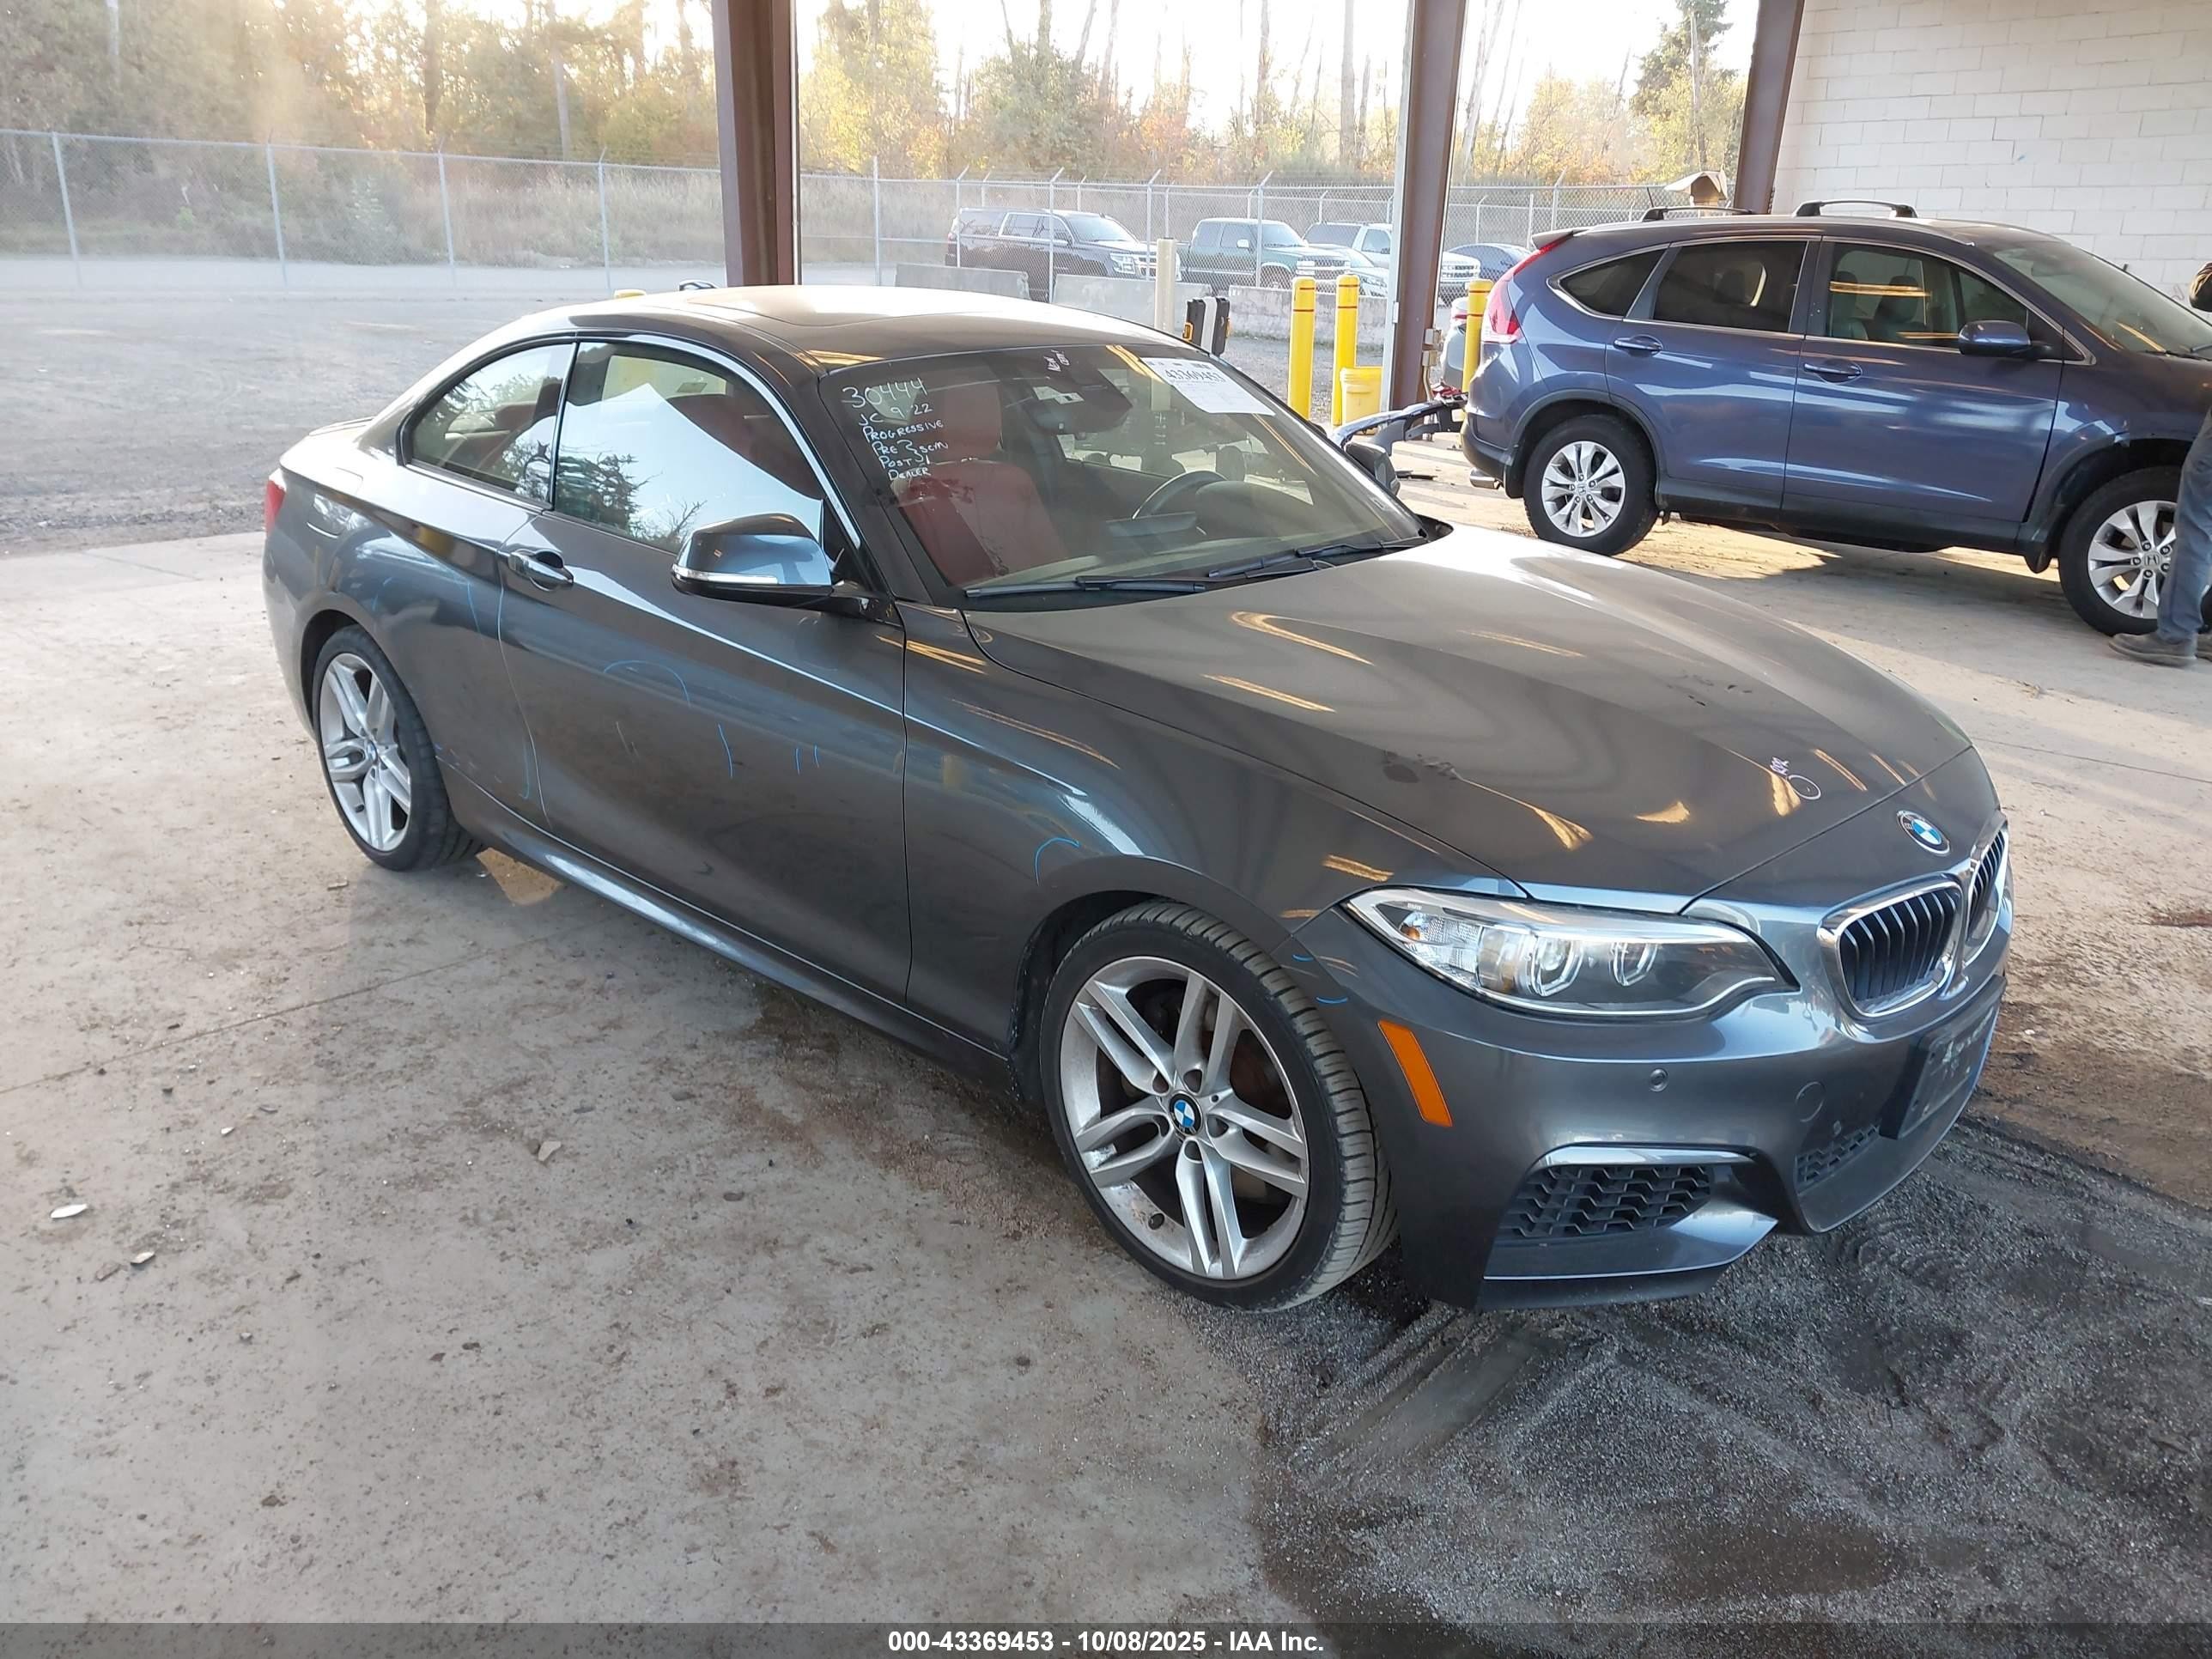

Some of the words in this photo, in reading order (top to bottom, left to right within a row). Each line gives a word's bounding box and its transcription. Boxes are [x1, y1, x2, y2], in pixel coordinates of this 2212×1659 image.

[842, 378, 927, 408] 30444
[862, 420, 944, 443] PROGRESSIVE
[872, 441, 898, 457] PRE
[878, 455, 912, 470] POST
[888, 467, 932, 481] DEALER
